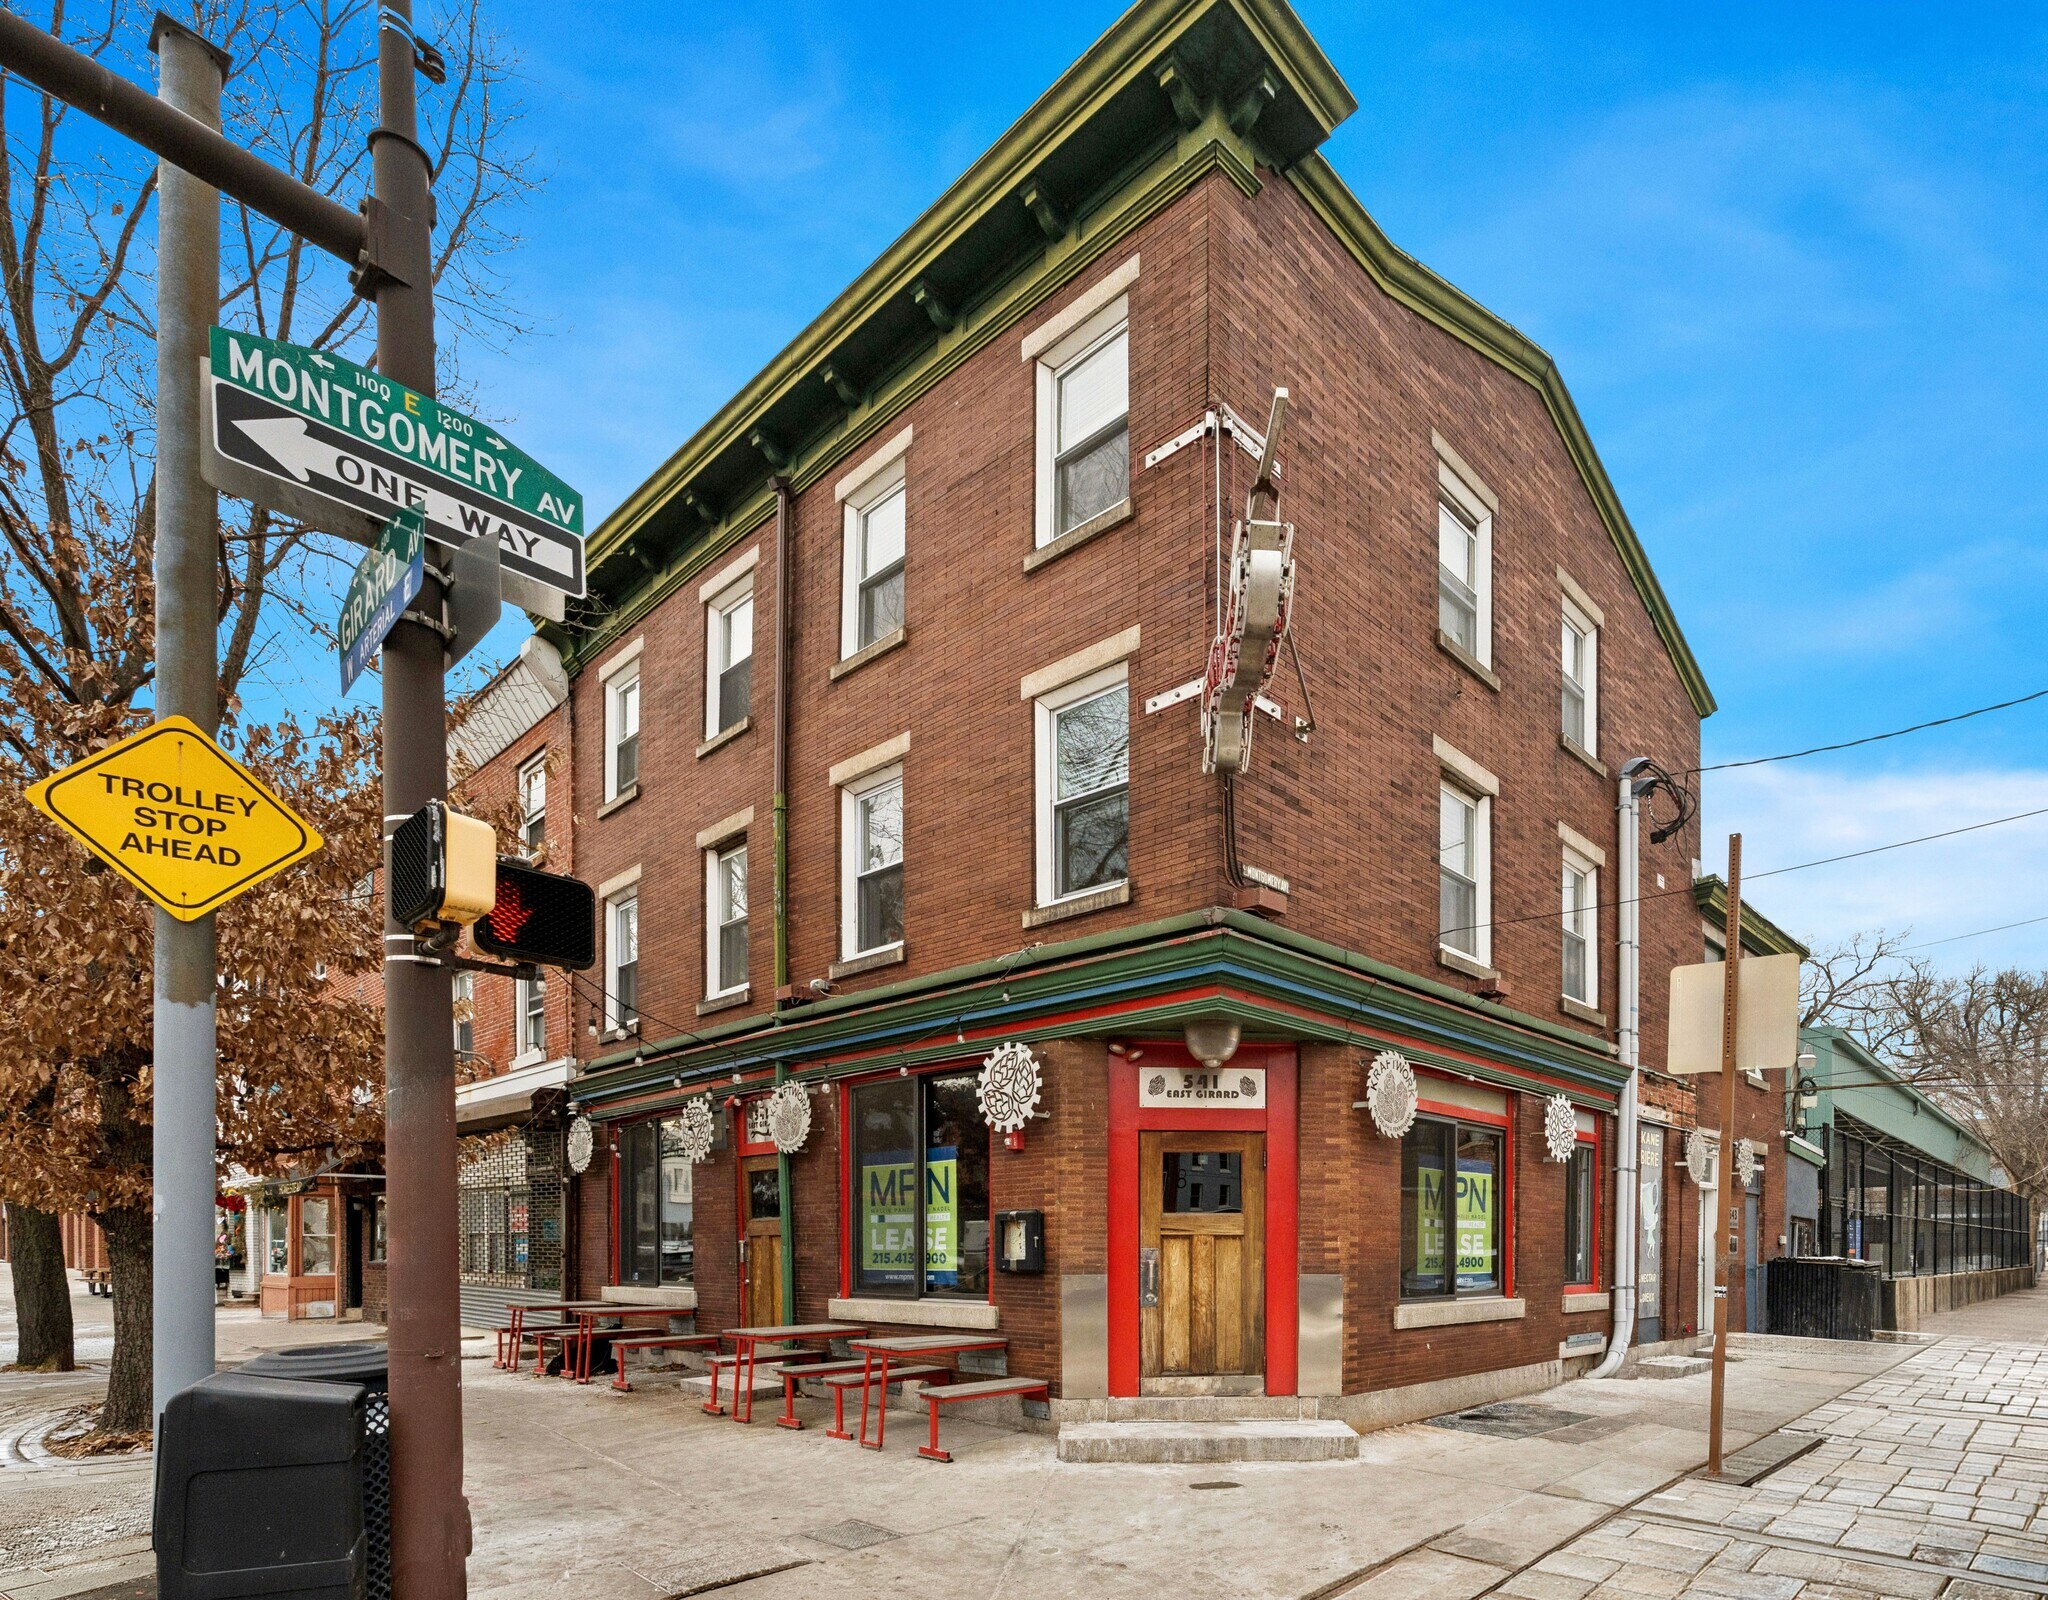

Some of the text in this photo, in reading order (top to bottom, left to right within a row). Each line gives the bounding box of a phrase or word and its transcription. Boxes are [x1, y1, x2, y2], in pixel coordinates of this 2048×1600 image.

[355, 371, 473, 437] 1100 E 1200
[229, 336, 575, 525] MONTGOMERY AV
[336, 455, 541, 558] ONE WAY
[342, 522, 421, 651] GIRARD AV
[346, 568, 413, 684] W ARTERIAL E
[97, 772, 259, 818] TROLLEY
[134, 806, 227, 838] STOP
[119, 832, 241, 867] AHEAD
[1166, 1089, 1240, 1099] EAST GIRARD
[1183, 1074, 1219, 1090] 541
[770, 1086, 809, 1117] KRFTWORK
[1640, 1130, 1660, 1147] KANE
[1424, 1232, 1485, 1255] LESE
